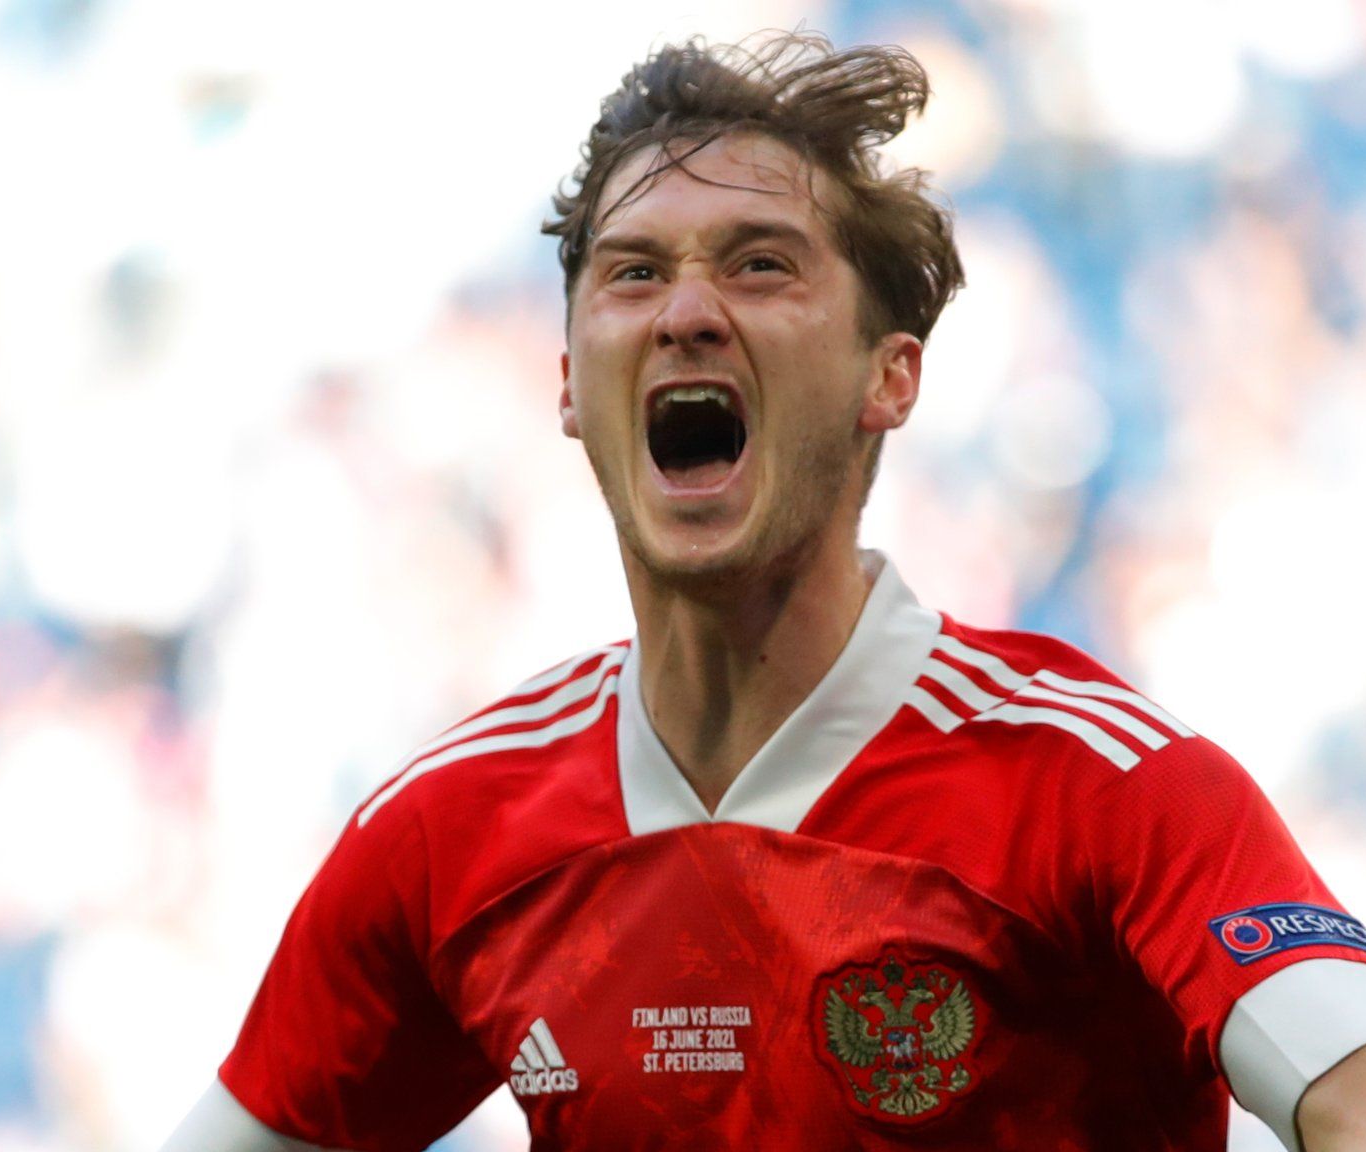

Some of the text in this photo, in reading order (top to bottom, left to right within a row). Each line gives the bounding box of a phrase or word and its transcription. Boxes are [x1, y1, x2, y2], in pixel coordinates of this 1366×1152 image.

[632, 1006, 751, 1028] FINLAND VS RUSSIA
[652, 1029, 736, 1050] 16 JUNE 2021
[643, 1051, 745, 1073] ST. PETERSBURG
[510, 1067, 579, 1096] adidas
